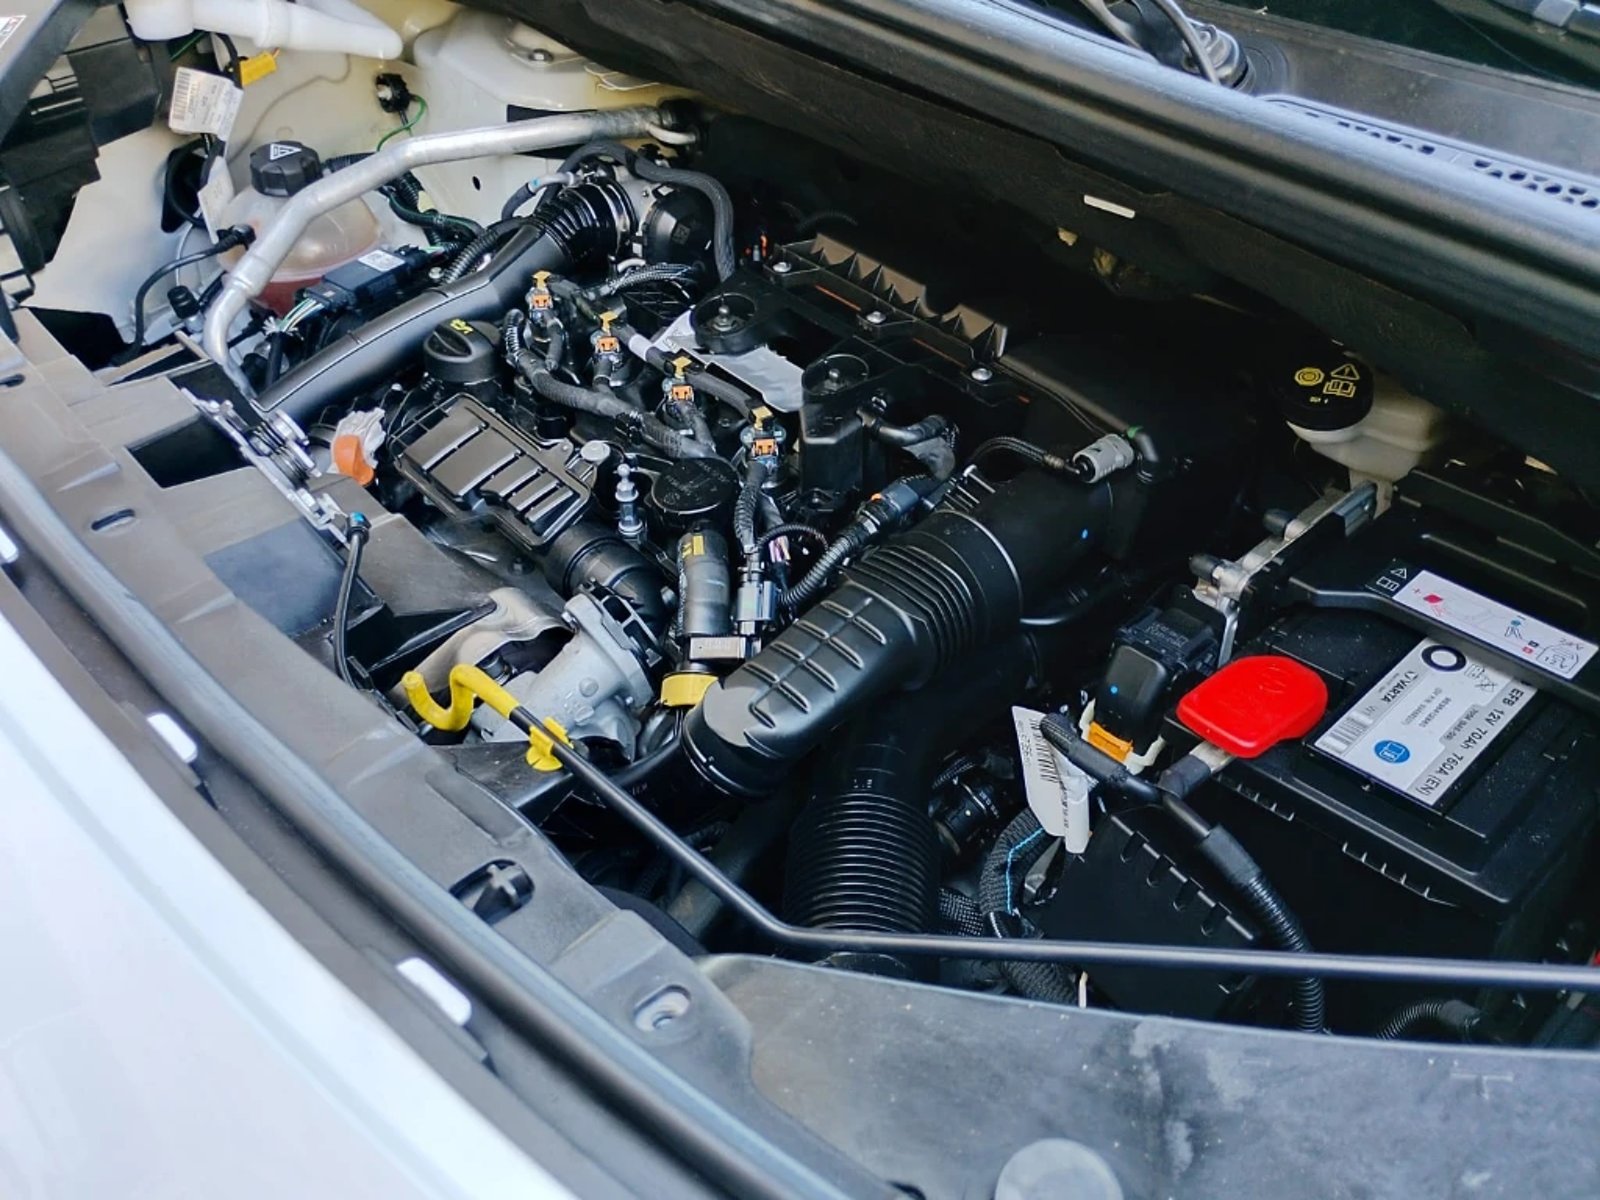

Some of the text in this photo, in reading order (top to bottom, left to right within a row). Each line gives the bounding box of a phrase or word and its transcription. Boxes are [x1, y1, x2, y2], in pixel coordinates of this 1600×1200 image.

[1381, 679, 1411, 702] VARTA
[1502, 688, 1524, 706] EFB
[1485, 708, 1505, 726] 12V
[1460, 727, 1488, 749] 70Ah
[1435, 753, 1464, 775] 760A
[1415, 775, 1442, 796] (EN)
